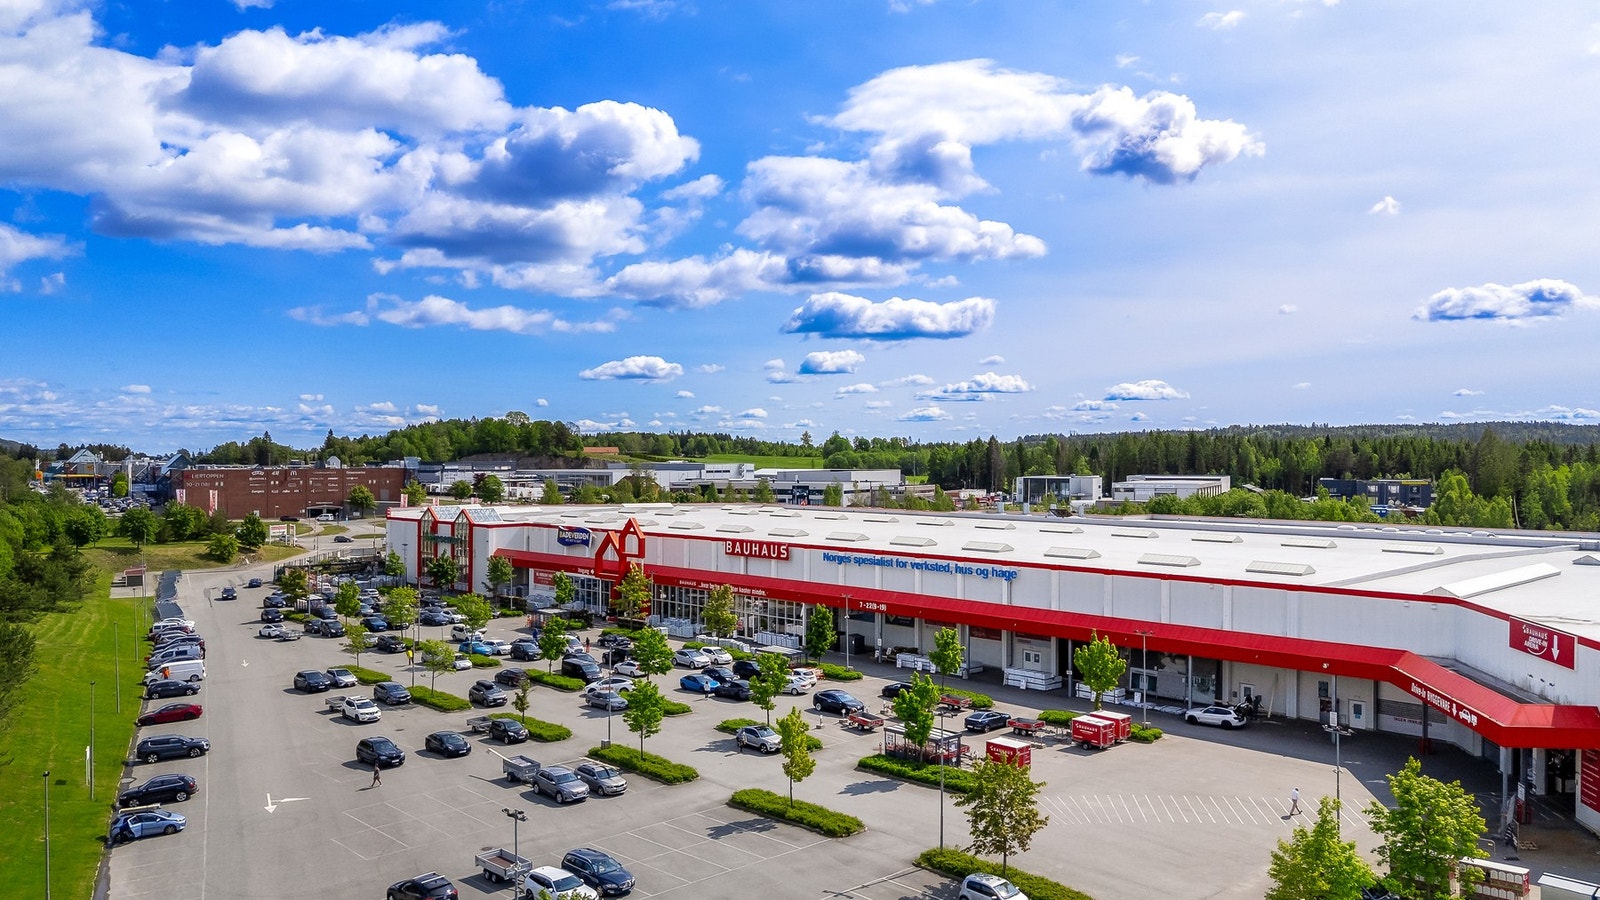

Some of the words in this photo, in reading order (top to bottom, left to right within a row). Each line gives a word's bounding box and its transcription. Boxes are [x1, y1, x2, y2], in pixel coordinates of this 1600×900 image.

[559, 531, 590, 540] BADEVERDEN
[726, 541, 788, 558] BAUHAUS
[822, 552, 852, 565] Norges
[853, 555, 894, 567] spesialist
[895, 558, 909, 569] for
[910, 561, 953, 575] verksted,
[955, 563, 974, 575] hus
[975, 568, 989, 579] og
[991, 567, 1018, 581] hage
[738, 586, 752, 594] koster
[1526, 627, 1548, 640] BAUHAUS
[1427, 690, 1451, 713] BYGGEVARE
[1078, 724, 1098, 733] BAUHAUS
